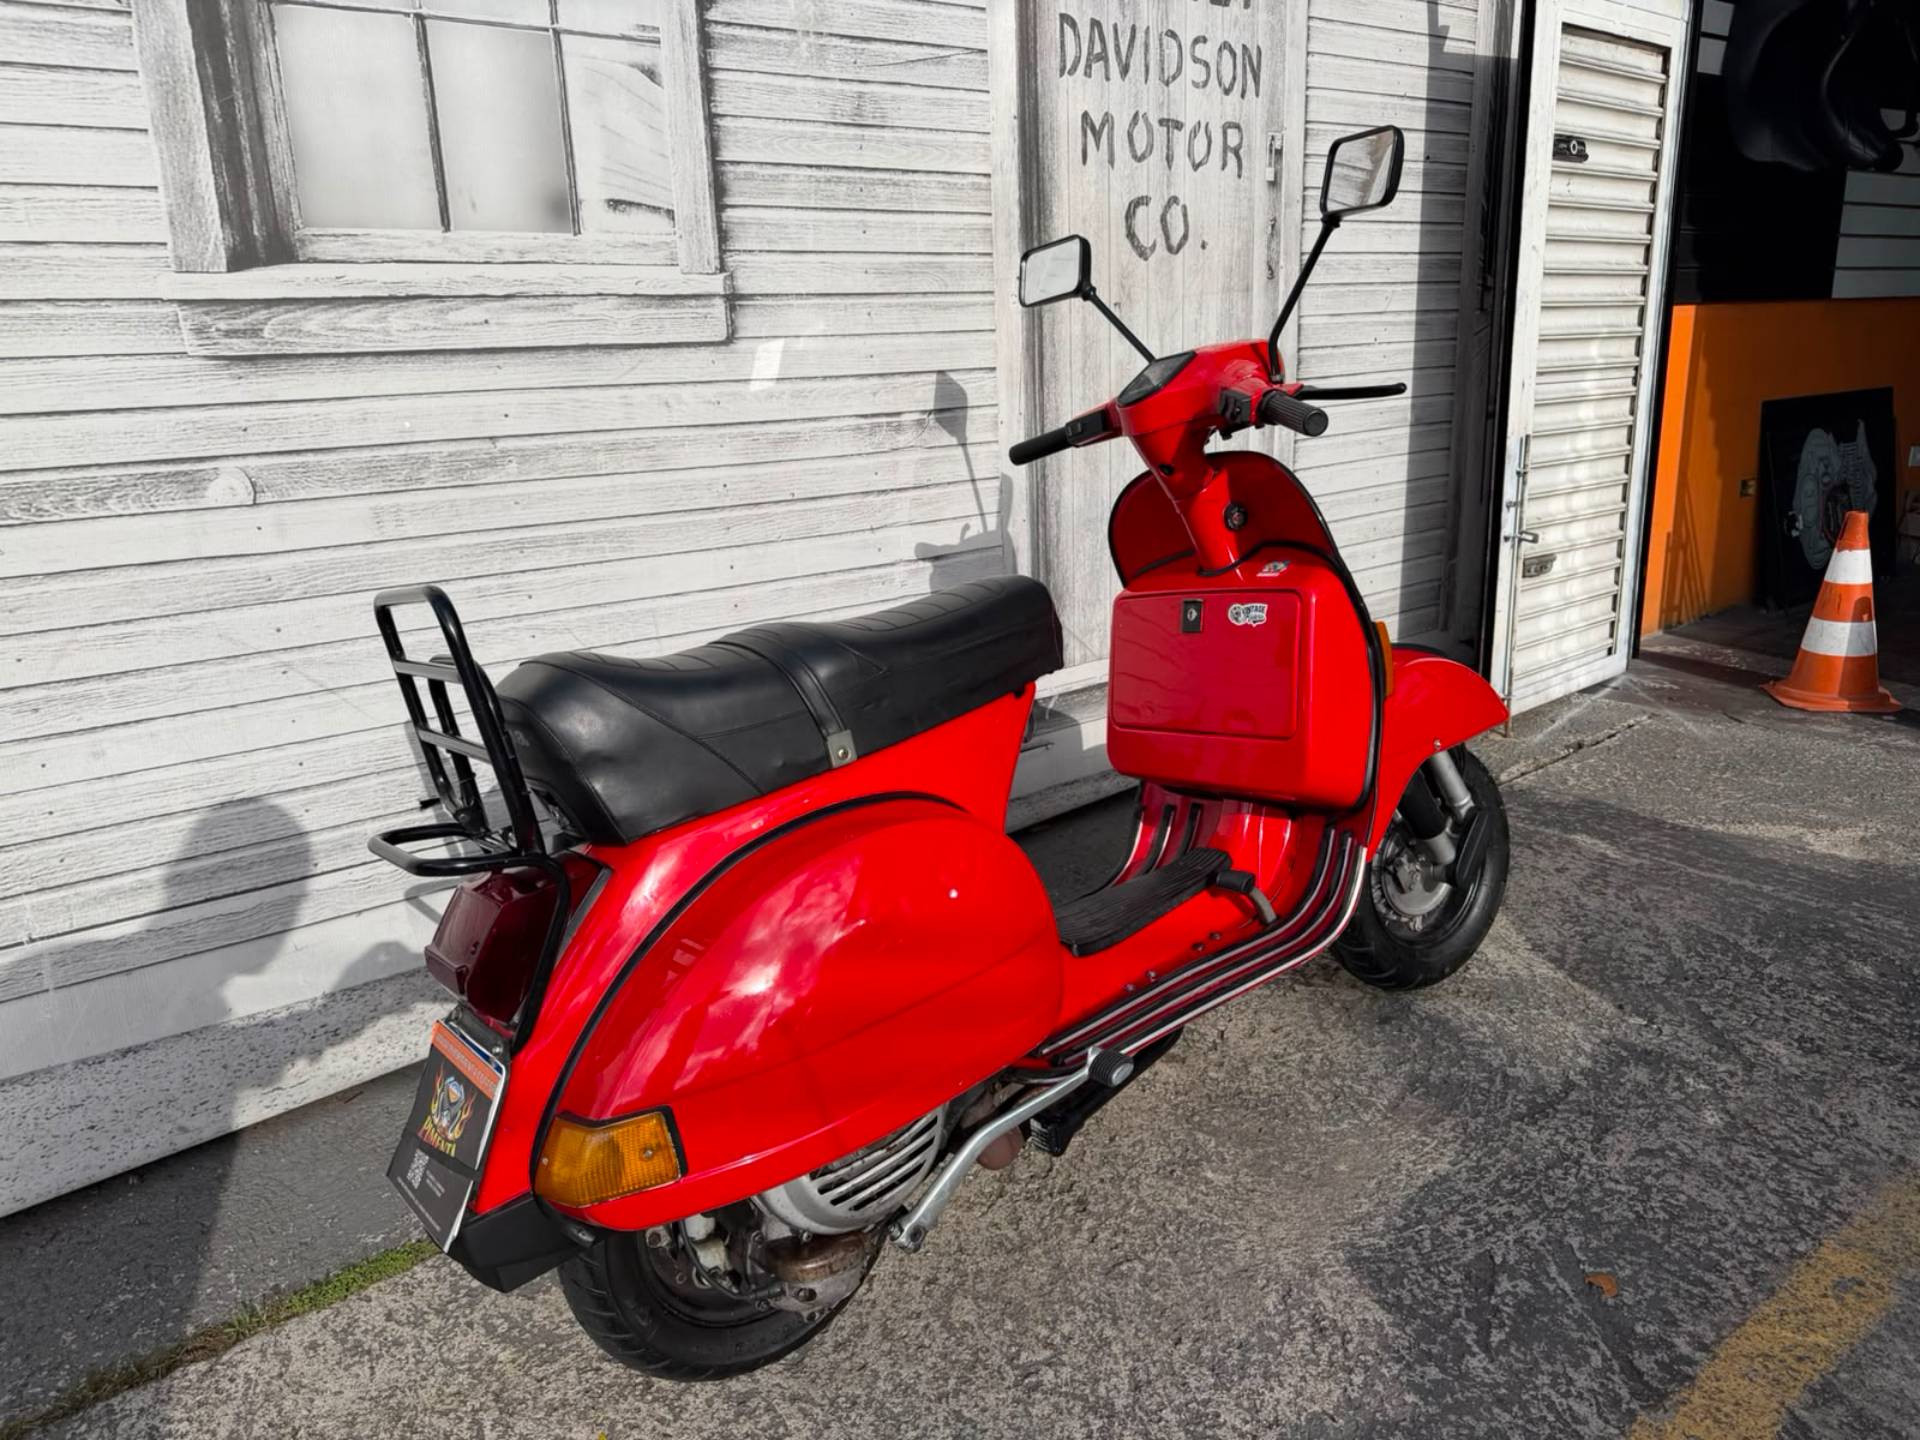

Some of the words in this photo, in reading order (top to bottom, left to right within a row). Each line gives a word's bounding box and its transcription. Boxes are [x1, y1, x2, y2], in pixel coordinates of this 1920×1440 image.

[1059, 12, 1262, 99] DAVIDSON
[1081, 110, 1243, 179] MOTOR
[1124, 195, 1208, 261] CO.
